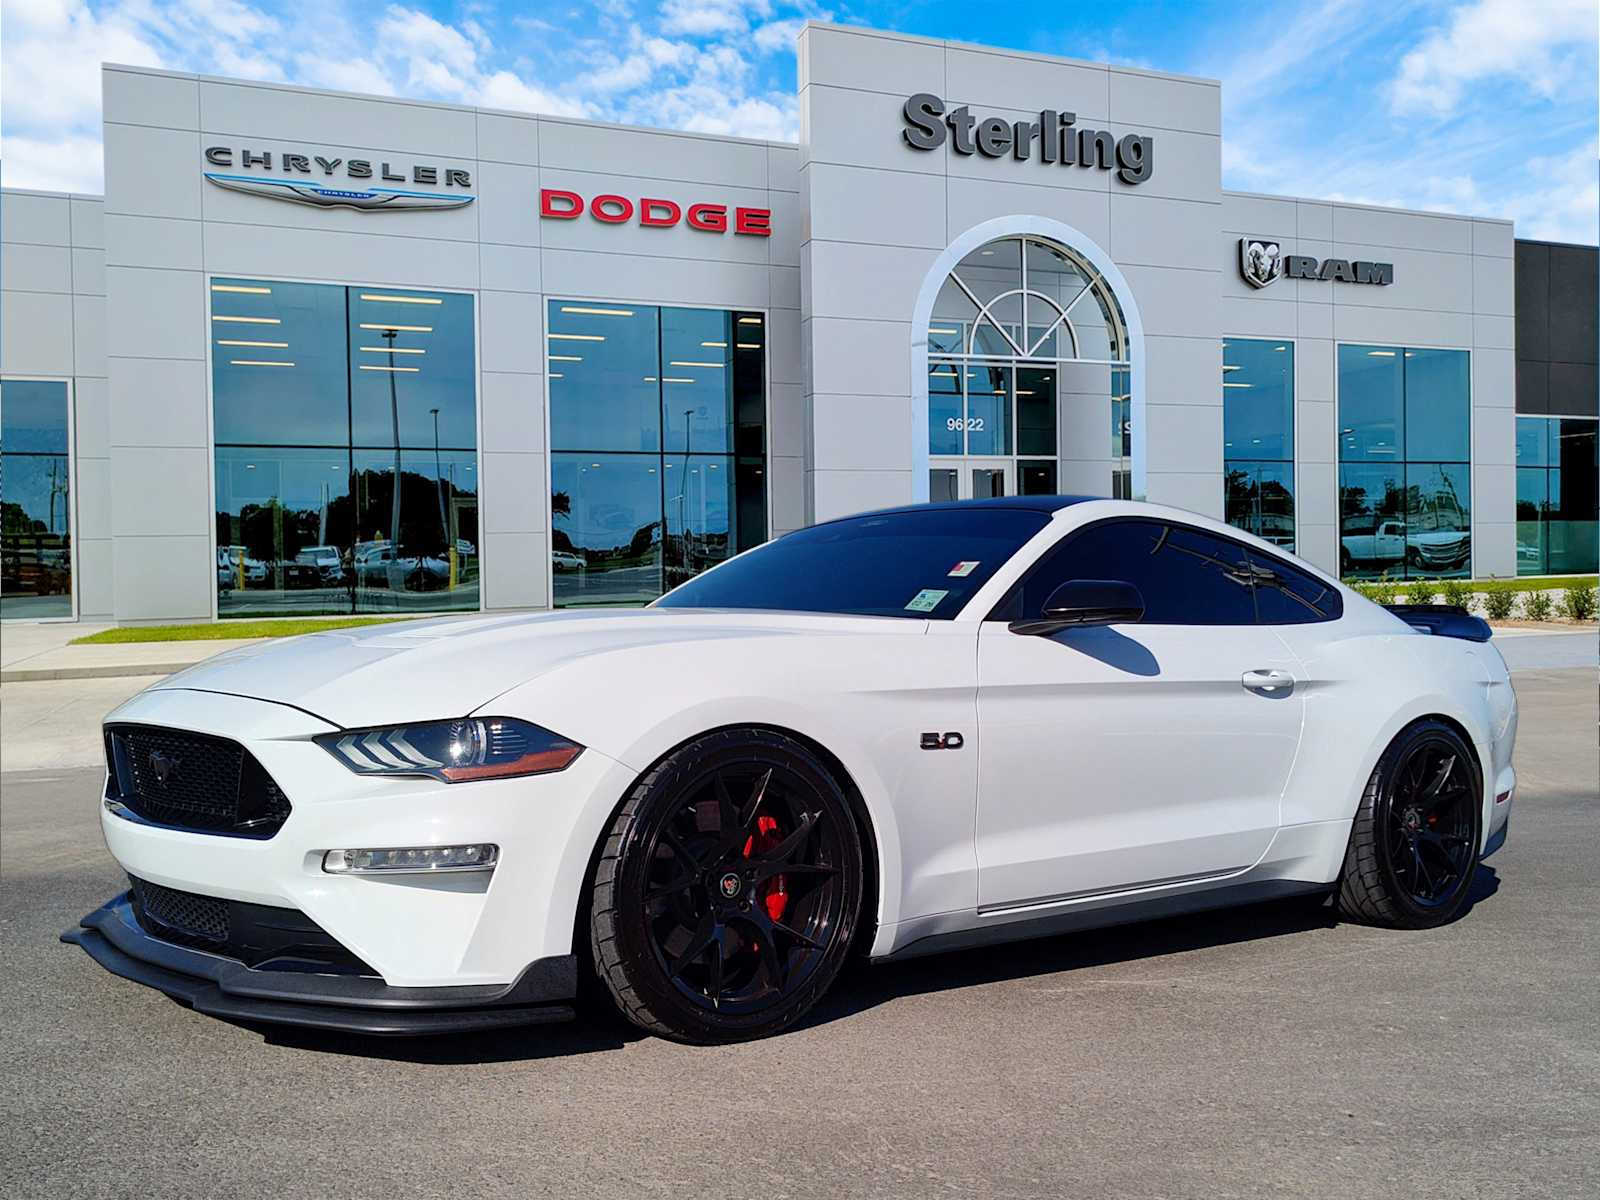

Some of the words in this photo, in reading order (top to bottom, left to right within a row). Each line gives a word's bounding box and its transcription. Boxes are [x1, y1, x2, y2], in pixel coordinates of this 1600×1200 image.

[903, 92, 1153, 184] Sterling
[204, 146, 472, 187] CHRYSLER
[540, 188, 771, 237] DODGE
[1284, 255, 1394, 285] RAM
[946, 417, 985, 431] 9622
[920, 732, 964, 750] 5.0
